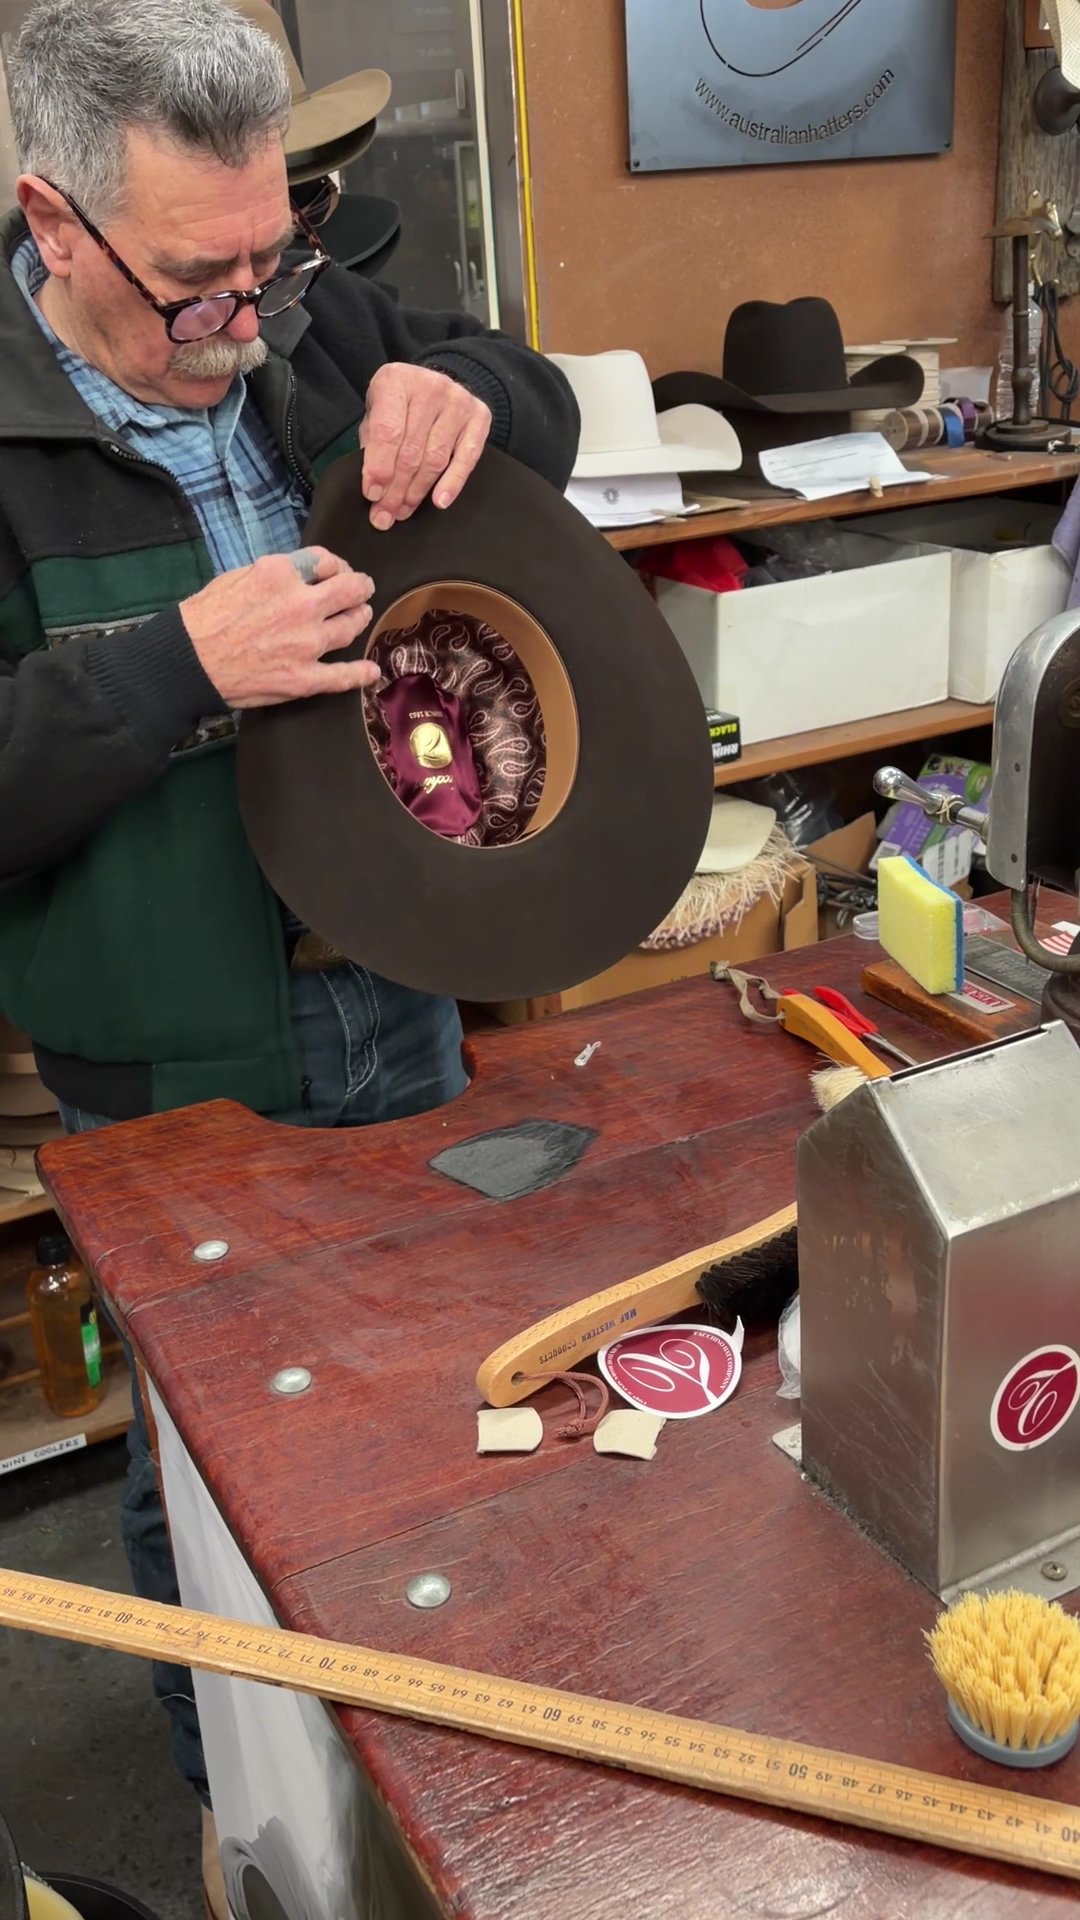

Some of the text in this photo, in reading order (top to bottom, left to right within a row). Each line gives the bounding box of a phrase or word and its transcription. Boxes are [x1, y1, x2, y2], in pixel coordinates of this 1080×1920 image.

[694, 68, 895, 145] www.australianhatters.com
[712, 743, 738, 759] RHIN
[582, 1320, 616, 1342] WESTERN
[540, 1340, 577, 1364] PRODUCTS
[719, 1357, 733, 1390] COMPANY
[34, 1438, 80, 1458] COOLERS
[1, 1587, 18, 1597] 86
[19, 1590, 37, 1601] 85
[38, 1594, 56, 1605] 84
[57, 1599, 75, 1610] 83
[76, 1603, 94, 1614] 82
[96, 1608, 113, 1618] 81
[113, 1610, 134, 1624] 80
[134, 1617, 152, 1627] 79
[154, 1621, 171, 1634] 78
[173, 1626, 191, 1637] 77
[195, 1629, 212, 1641] 76
[214, 1634, 232, 1645] 75
[235, 1638, 252, 1650] 74
[255, 1643, 273, 1655] 73
[276, 1648, 294, 1660] 72
[299, 1653, 315, 1664] 71
[317, 1655, 337, 1671] 70
[340, 1663, 358, 1673] 69
[362, 1667, 380, 1678] 68
[383, 1672, 402, 1683] 67
[407, 1676, 424, 1688] 66
[427, 1682, 446, 1694] 65
[450, 1686, 469, 1698] 64
[473, 1692, 492, 1704] 63
[496, 1697, 515, 1709] 62
[520, 1702, 538, 1714] 61
[541, 1706, 562, 1722] 60
[566, 1713, 585, 1725] 59
[590, 1718, 609, 1731] 58
[614, 1724, 633, 1736] 57
[639, 1729, 657, 1742] 56
[663, 1734, 682, 1748] 55
[687, 1740, 707, 1753] 54
[712, 1745, 732, 1759] 53
[737, 1751, 757, 1765] 52
[764, 1757, 782, 1771] 51
[787, 1761, 809, 1780] 50
[814, 1770, 834, 1783] 49
[840, 1775, 860, 1789] 48
[867, 1782, 887, 1795] 47
[894, 1788, 914, 1802] 46
[921, 1794, 941, 1808] 45
[948, 1801, 969, 1815] 44
[976, 1807, 996, 1821] 43
[1004, 1814, 1024, 1828] 42
[1033, 1819, 1052, 1834] 41
